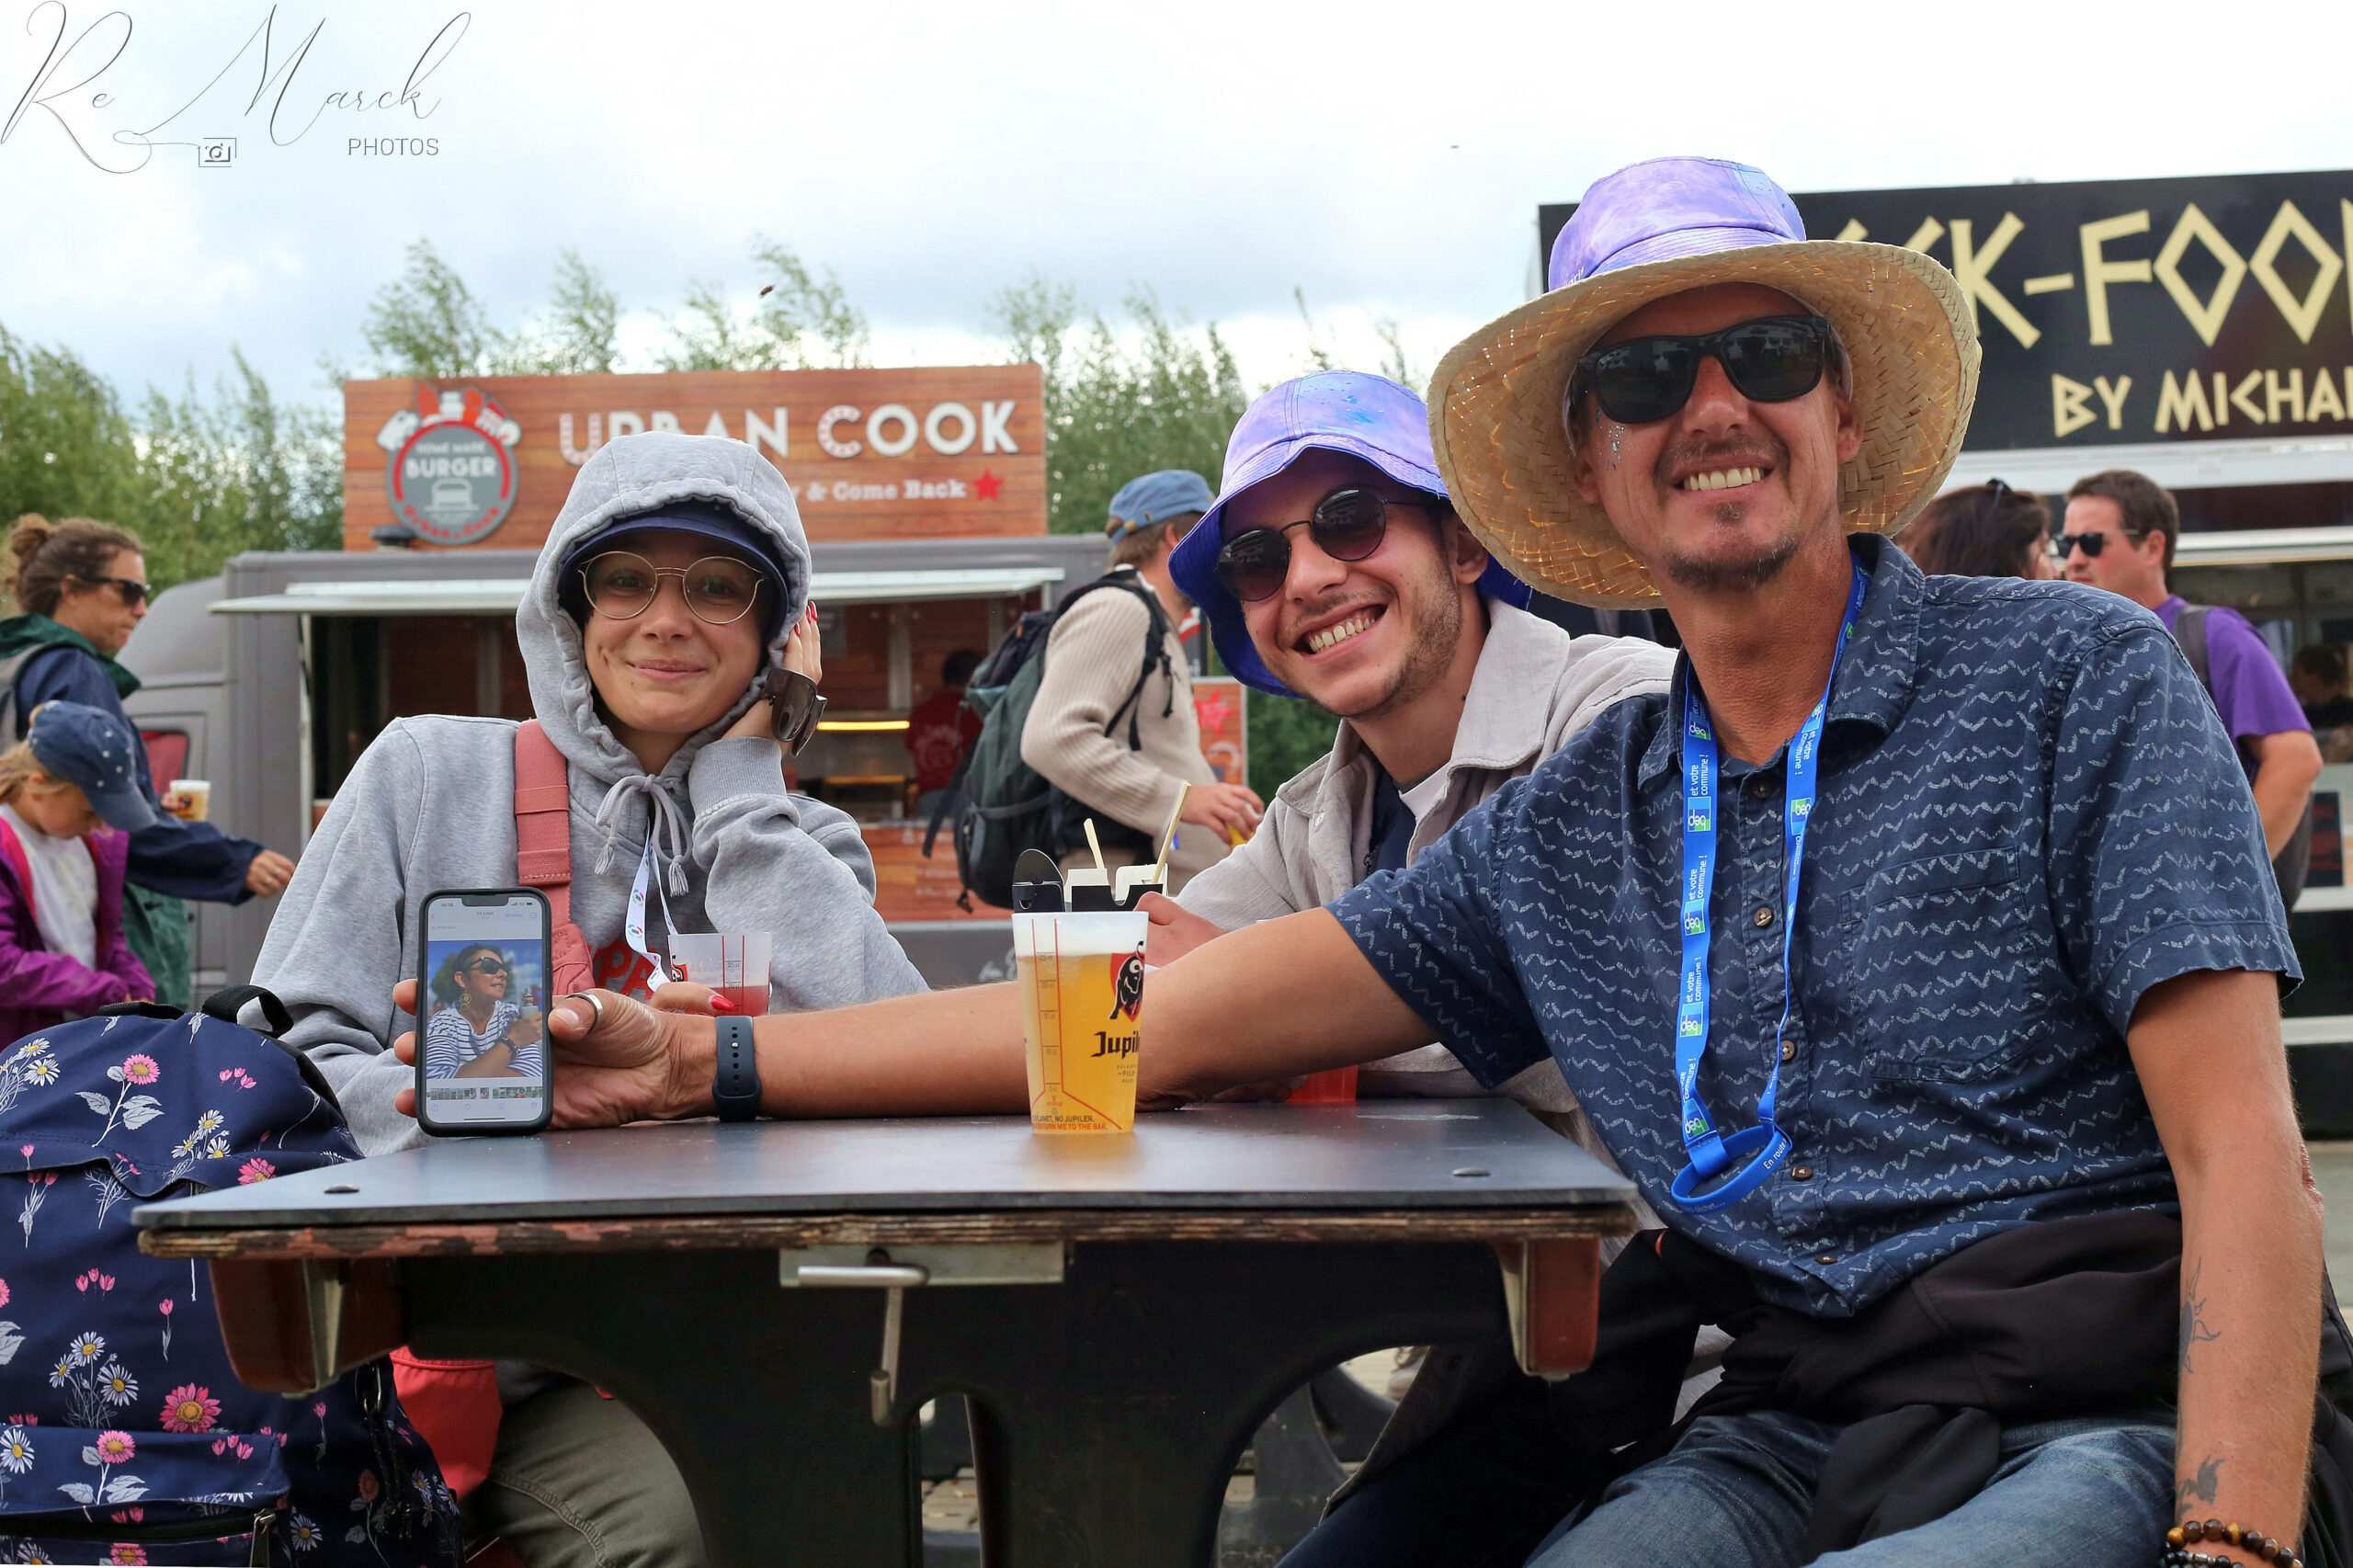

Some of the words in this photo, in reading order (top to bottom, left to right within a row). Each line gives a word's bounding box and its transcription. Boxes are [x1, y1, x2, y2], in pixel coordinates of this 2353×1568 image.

[1835, 199, 2353, 349] K-FOO
[2052, 373, 2132, 438] BY
[817, 401, 1019, 458] COOK
[405, 456, 496, 479] BURGER
[806, 482, 827, 502] &
[832, 481, 898, 501] Come
[903, 478, 967, 499] Back
[1794, 733, 1809, 769] commune
[1690, 765, 1699, 787] votre
[1699, 758, 1709, 796] commune
[1689, 787, 1699, 797] et
[1689, 869, 1698, 891] votre
[1697, 860, 1707, 899] commune
[1688, 891, 1697, 901] et
[1687, 971, 1695, 994] votre
[1694, 962, 1702, 1002] commune
[1686, 994, 1694, 1003] et
[1763, 1158, 1775, 1170] En
